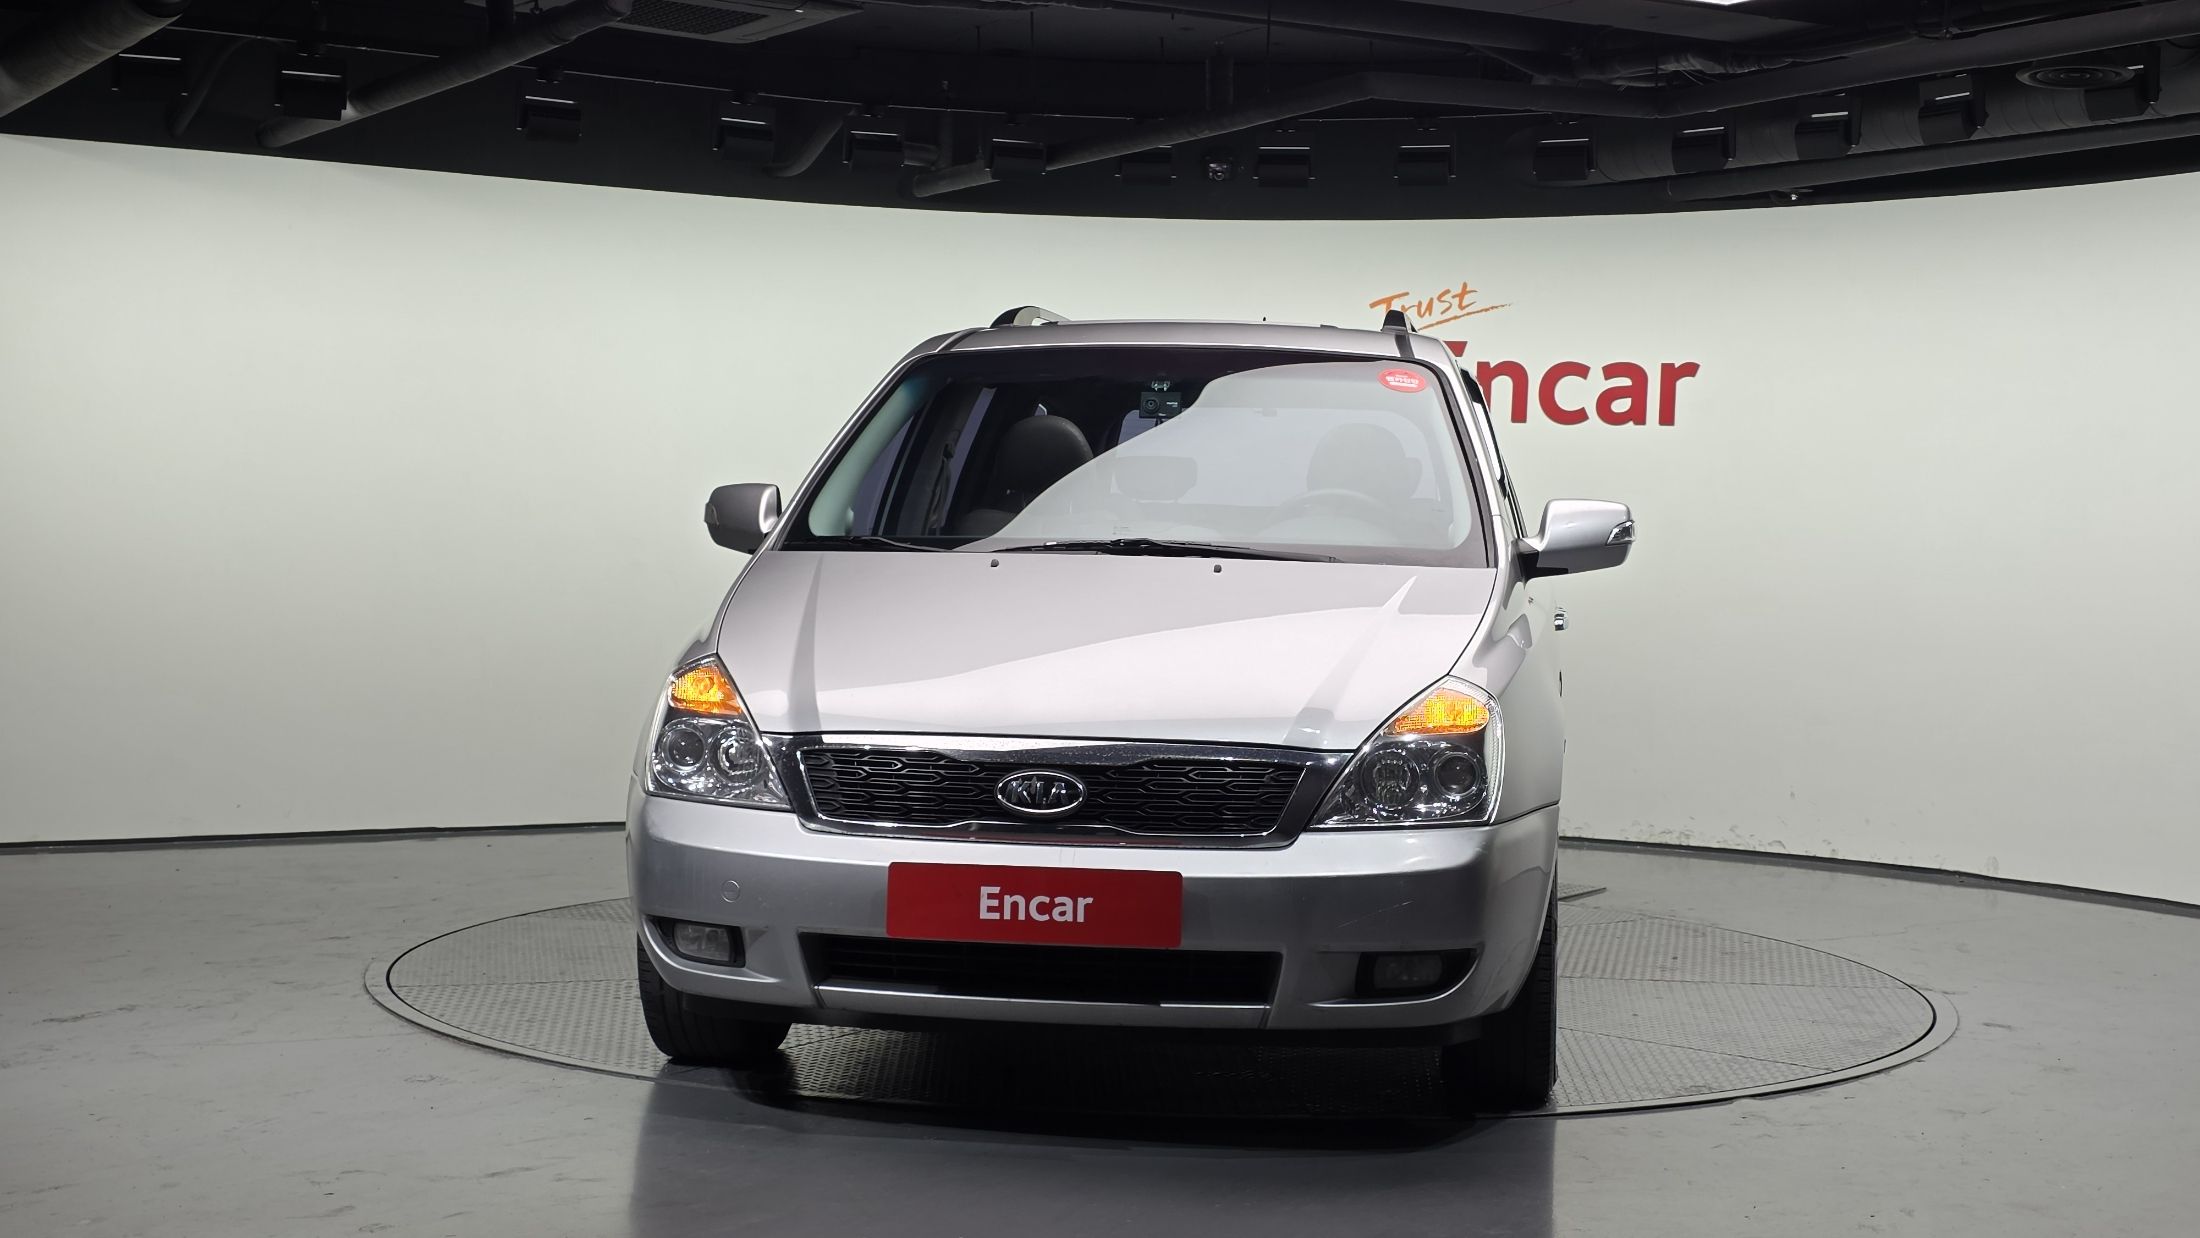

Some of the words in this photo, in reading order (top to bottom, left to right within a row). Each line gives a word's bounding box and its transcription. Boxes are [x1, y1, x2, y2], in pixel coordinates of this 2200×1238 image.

[1369, 281, 1478, 318] Trust
[1443, 340, 1701, 426] ncar
[1005, 778, 1072, 804] KIA
[980, 886, 1094, 922] Encar
